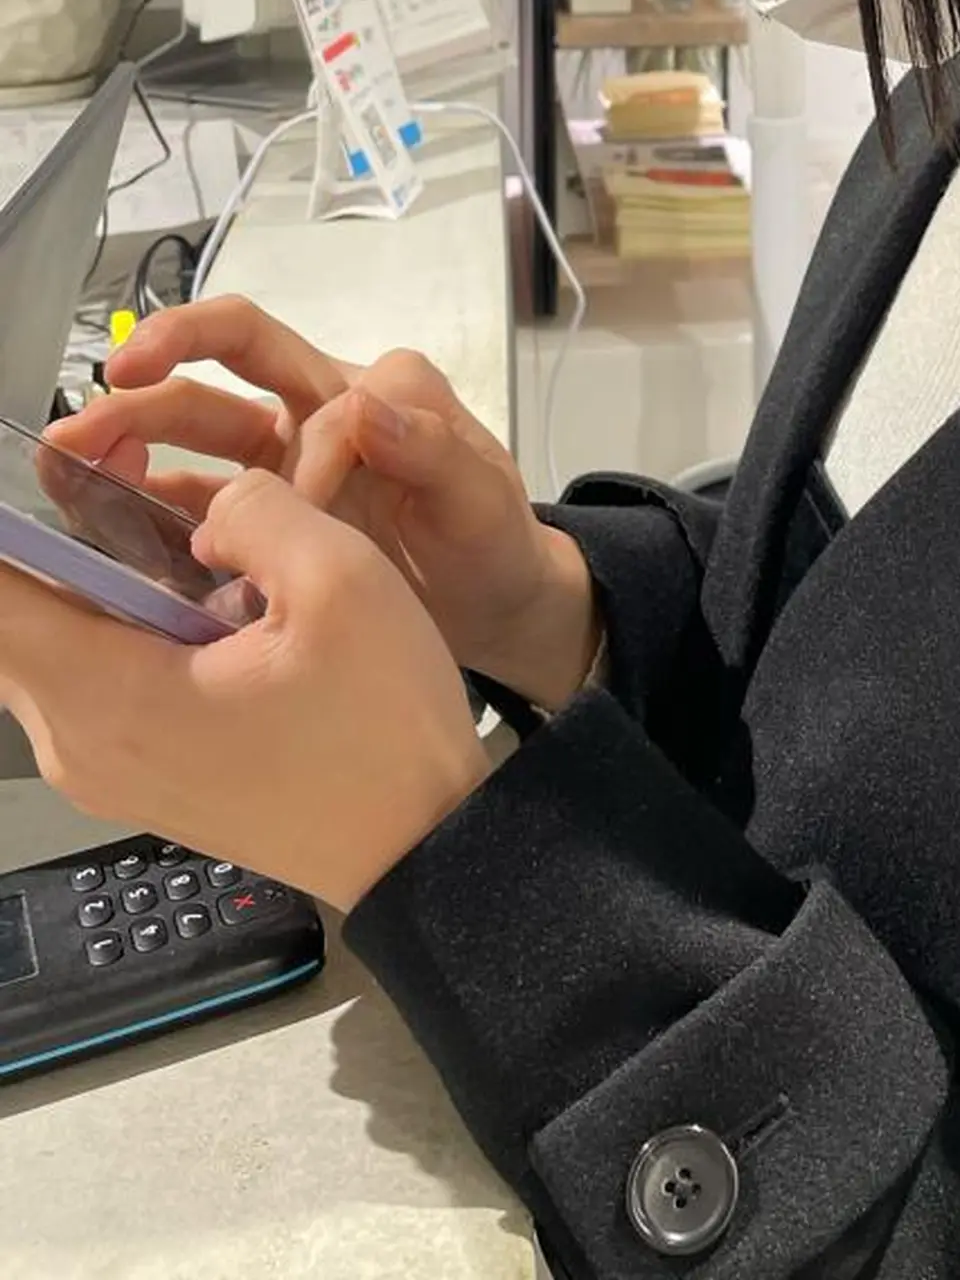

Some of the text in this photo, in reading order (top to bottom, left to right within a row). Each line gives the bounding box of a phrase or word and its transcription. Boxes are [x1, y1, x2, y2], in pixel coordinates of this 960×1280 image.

[119, 855, 140, 866] 6
[76, 867, 97, 880] 3
[213, 862, 234, 875] 0
[169, 873, 191, 887] 8
[127, 887, 149, 899] 5
[84, 900, 105, 913] 2
[181, 913, 203, 925] 7
[140, 924, 159, 936] 4
[92, 938, 113, 950] 1
